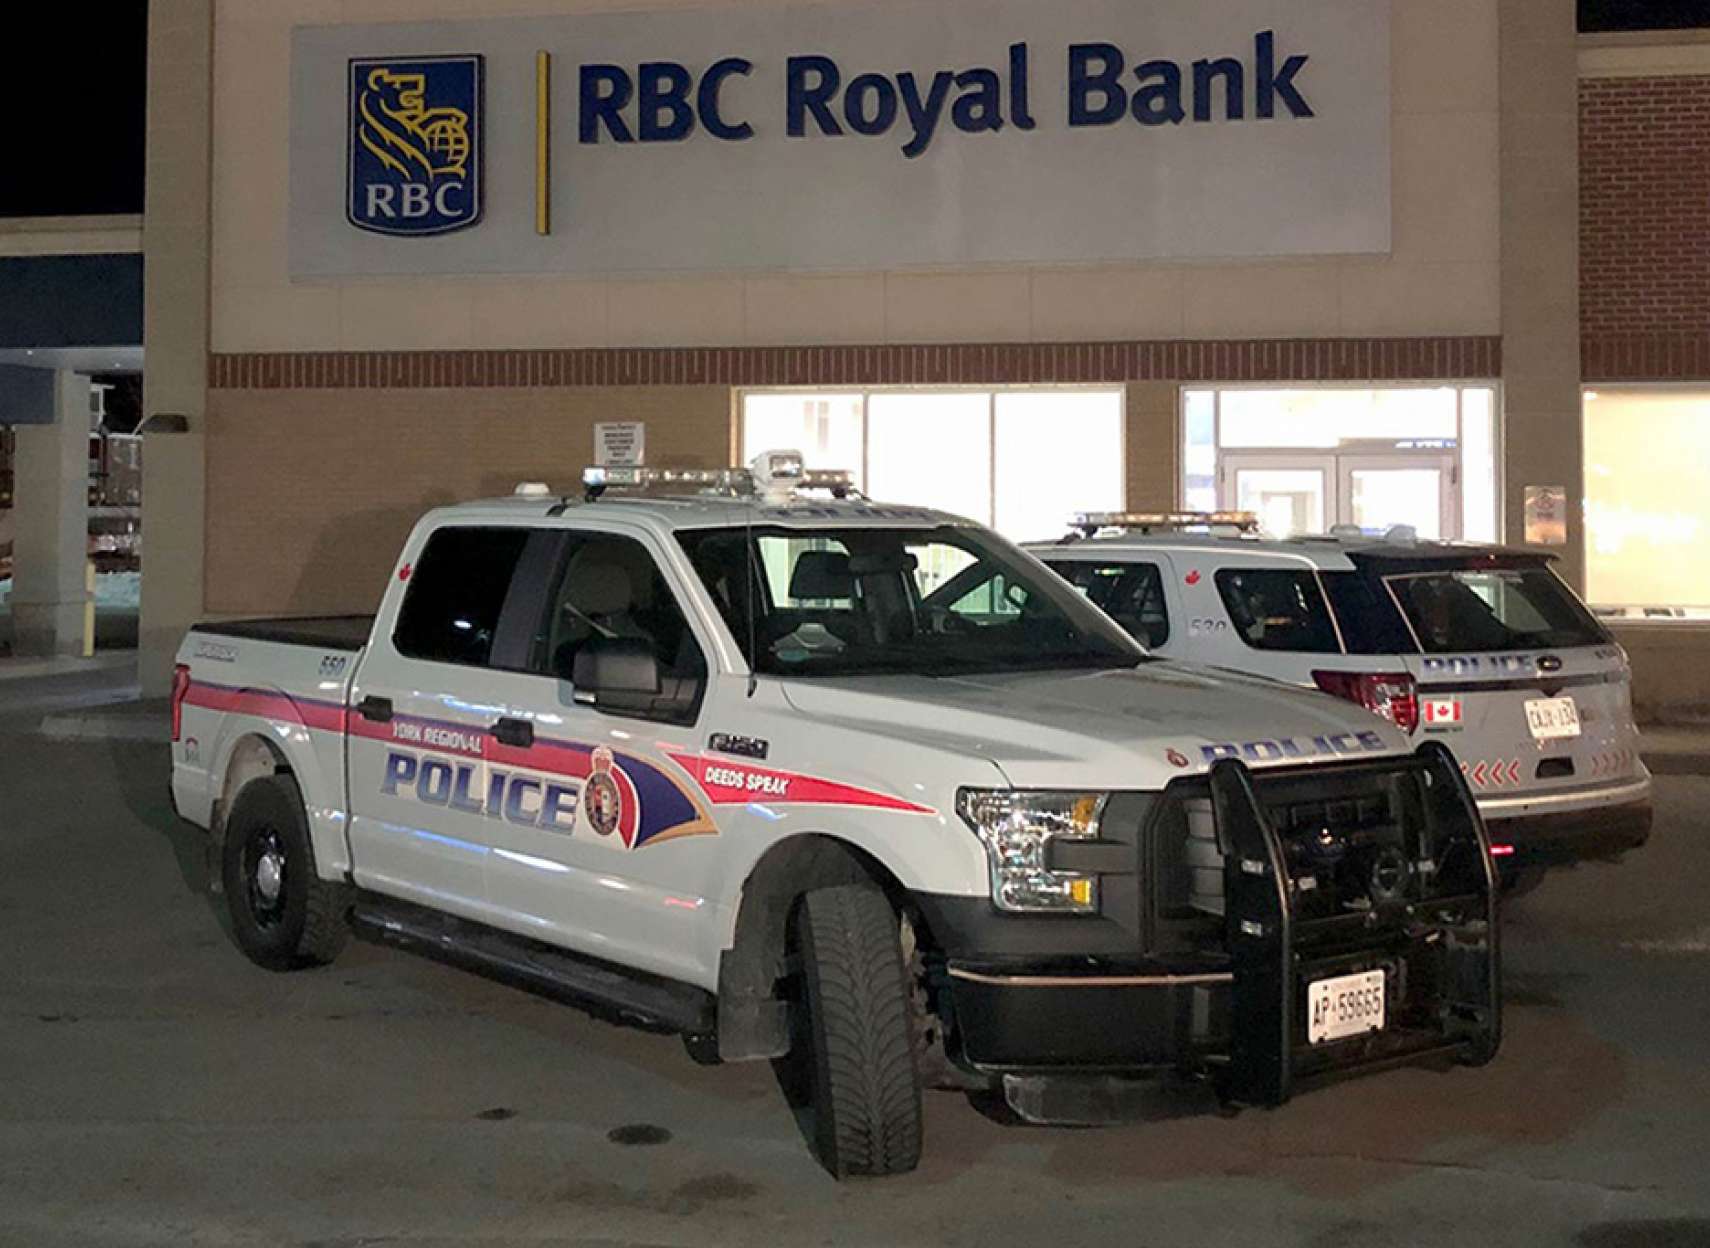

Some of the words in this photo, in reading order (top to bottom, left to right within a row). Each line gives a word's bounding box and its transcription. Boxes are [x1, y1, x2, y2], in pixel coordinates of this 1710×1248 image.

[578, 57, 755, 144] RBC
[785, 41, 1037, 159] Royal
[1067, 30, 1315, 127] Bank
[365, 181, 464, 218] RBC
[1423, 655, 1536, 678] POLICE
[392, 720, 422, 742] YORK
[423, 726, 483, 754] REGIONAL
[1199, 730, 1388, 761] POLICE
[379, 752, 579, 836] POLICE
[705, 766, 745, 789] DEEDS
[746, 773, 789, 795] SPEAK
[1313, 996, 1329, 1027] AP
[1339, 986, 1381, 1021] 59665
